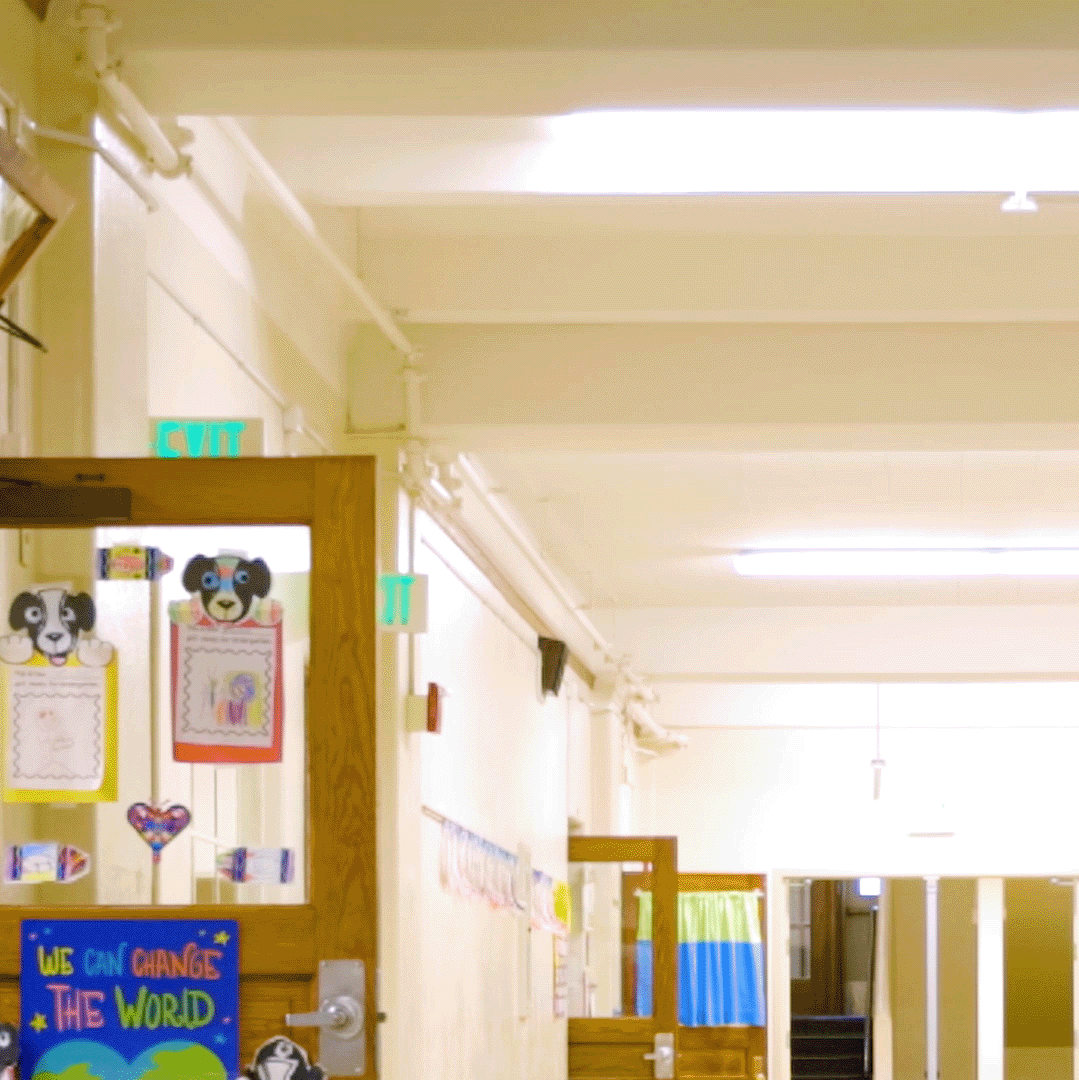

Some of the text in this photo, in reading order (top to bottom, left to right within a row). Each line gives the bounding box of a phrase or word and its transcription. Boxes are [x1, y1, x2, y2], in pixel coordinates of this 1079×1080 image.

[378, 575, 417, 626] IT
[37, 941, 224, 980] WE CAN CHANGE
[45, 982, 216, 1032] THE WORLD
